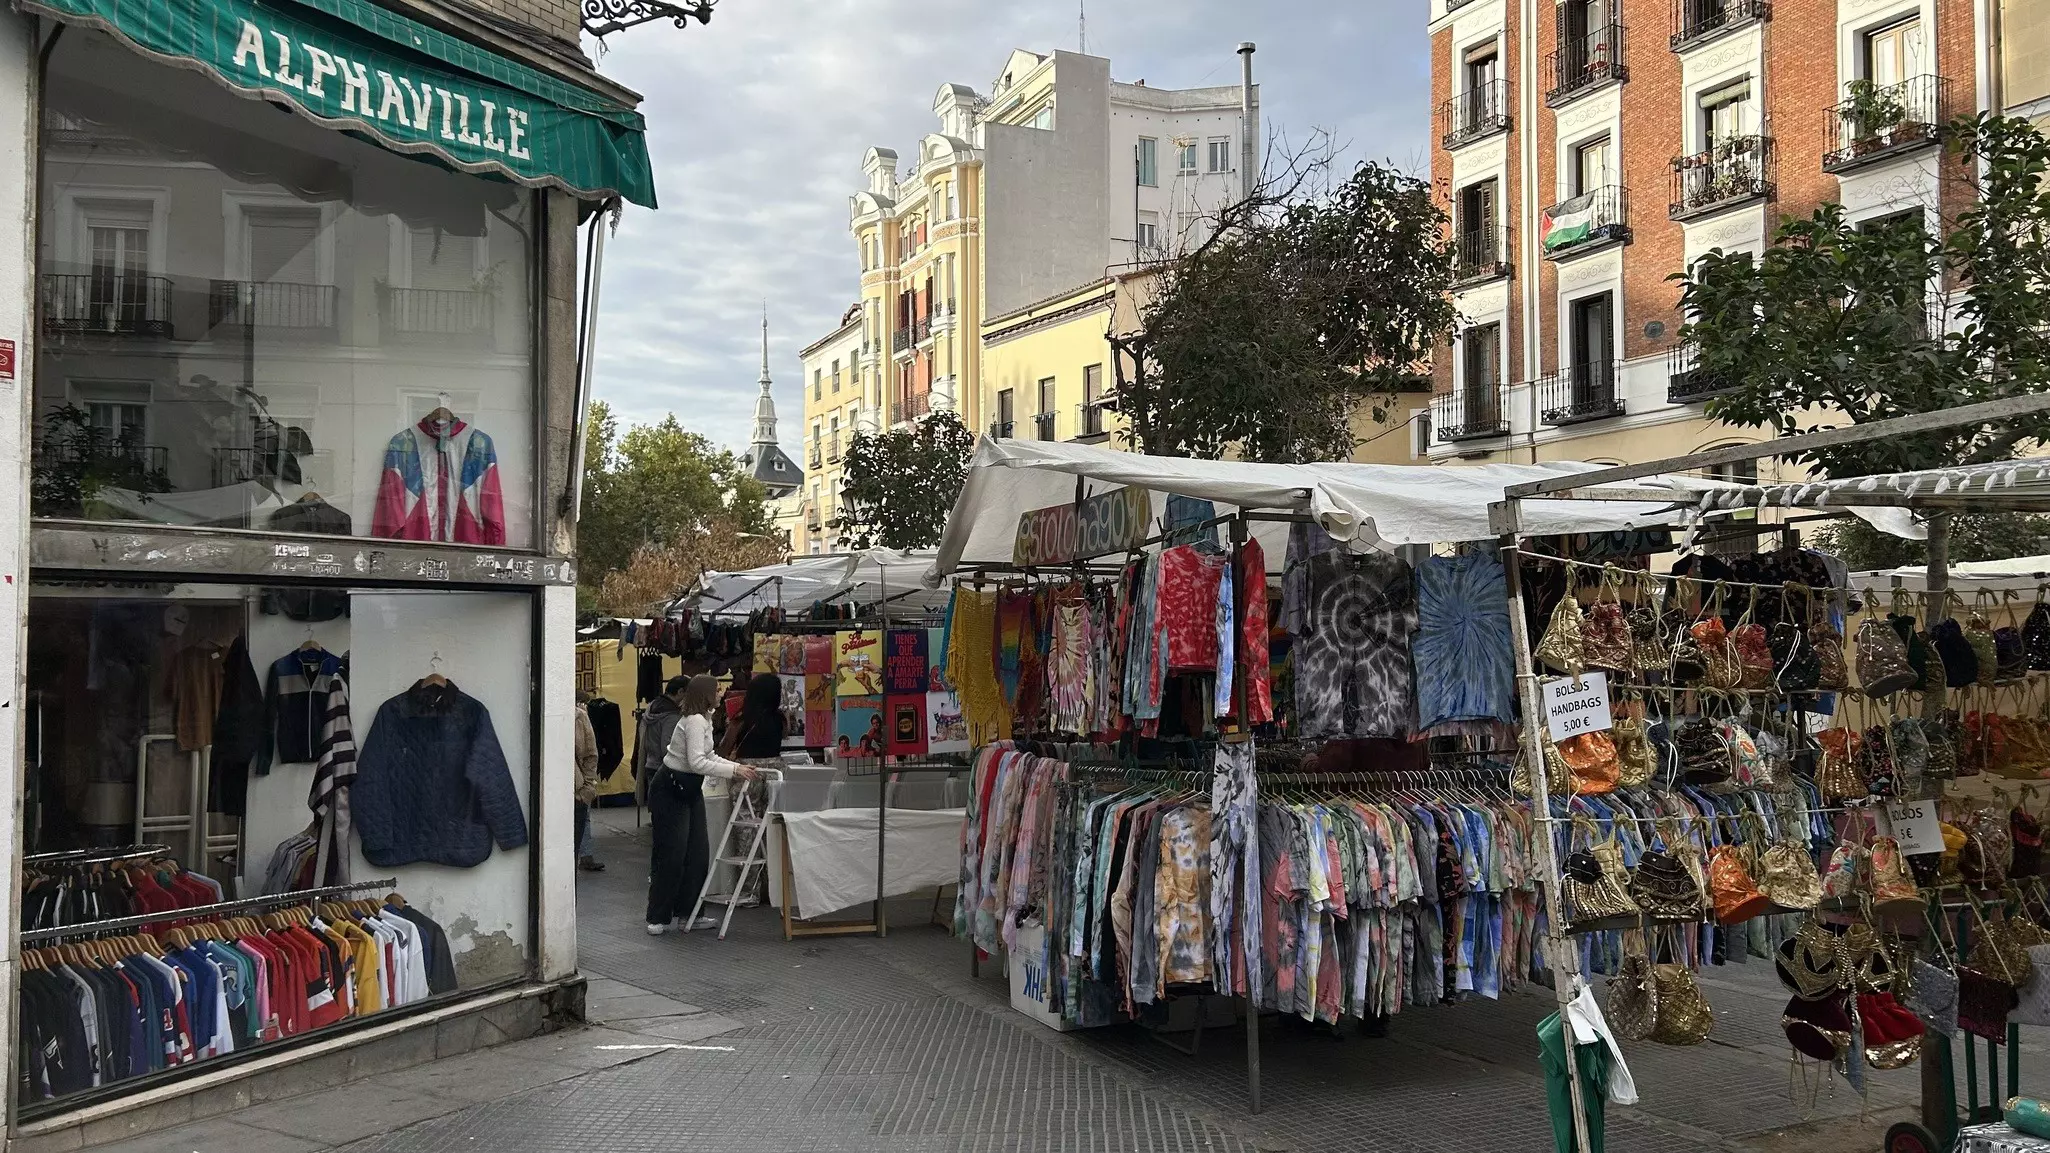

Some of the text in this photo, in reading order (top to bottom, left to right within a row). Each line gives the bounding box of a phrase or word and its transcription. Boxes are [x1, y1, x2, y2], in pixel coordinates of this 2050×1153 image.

[233, 17, 530, 160] ALPHAVILLE
[895, 633, 918, 645] TIENES
[898, 645, 914, 655] QUE
[887, 655, 925, 667] APRENDER
[887, 666, 925, 678] A AMARTE
[894, 677, 918, 689] PERRA
[1550, 696, 1602, 717] HANDBAGS
[1564, 716, 1590, 732] 5,00 €
[1906, 828, 1913, 838] €
